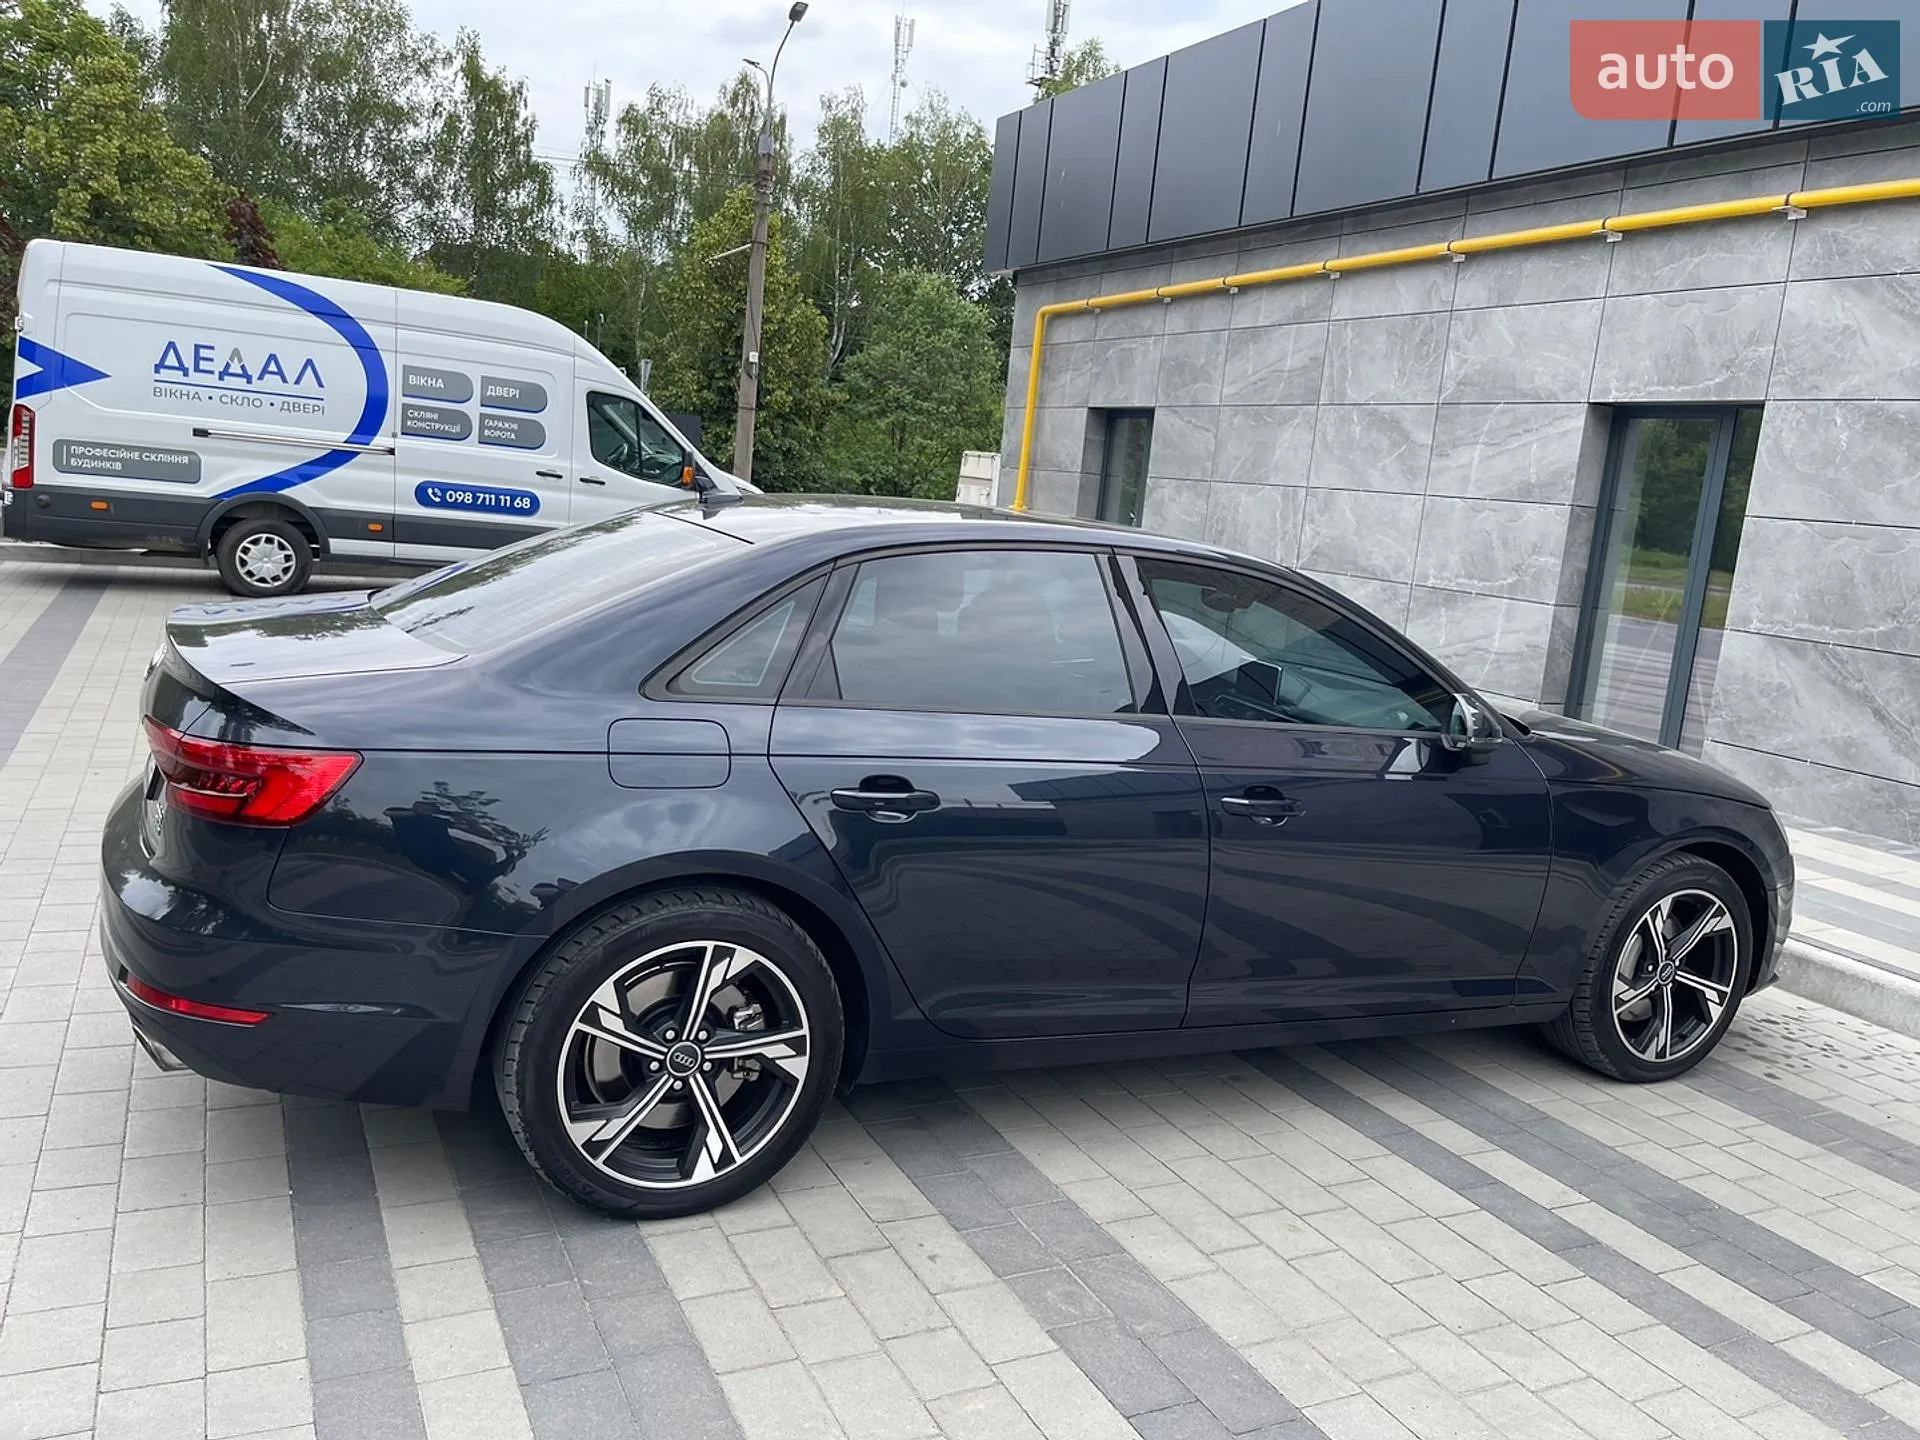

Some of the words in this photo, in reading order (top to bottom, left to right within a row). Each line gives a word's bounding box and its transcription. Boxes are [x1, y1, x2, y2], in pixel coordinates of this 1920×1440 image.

[153, 340, 325, 389] ДЕДАЛ
[409, 374, 445, 389] ВІКНА
[486, 385, 520, 399] ДВЕРІ
[152, 386, 202, 402] ВІКНА
[218, 393, 264, 409] СКЛО
[279, 400, 325, 416] ДВЕРІ
[407, 409, 439, 420] СКЛЯНІ
[483, 428, 516, 440] ВОРОТА
[70, 445, 140, 460] ПРОФЕСІЙНЕ
[142, 452, 189, 465] СКЛІННЯ
[70, 457, 122, 471] БУДИНКІВ
[446, 490, 473, 504] 098
[476, 493, 496, 506] 711
[499, 495, 511, 507] 11
[513, 497, 531, 509] 68
